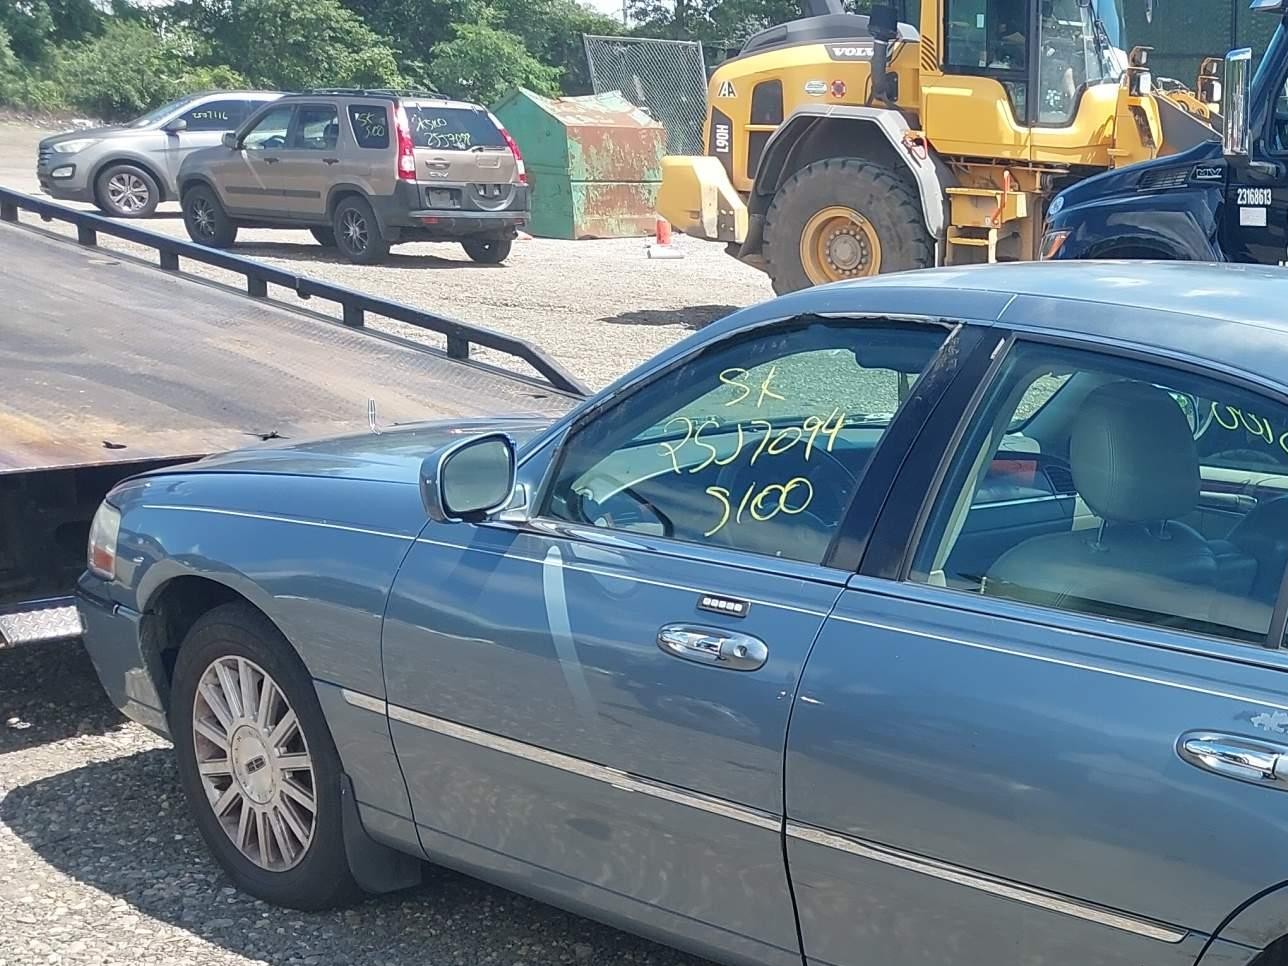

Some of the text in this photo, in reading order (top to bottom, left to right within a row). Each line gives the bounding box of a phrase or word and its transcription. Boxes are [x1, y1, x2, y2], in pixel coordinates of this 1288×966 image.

[832, 47, 874, 57] VOLV
[716, 124, 729, 153] L90H
[1196, 168, 1222, 176] MV
[1237, 188, 1272, 205] 23168613
